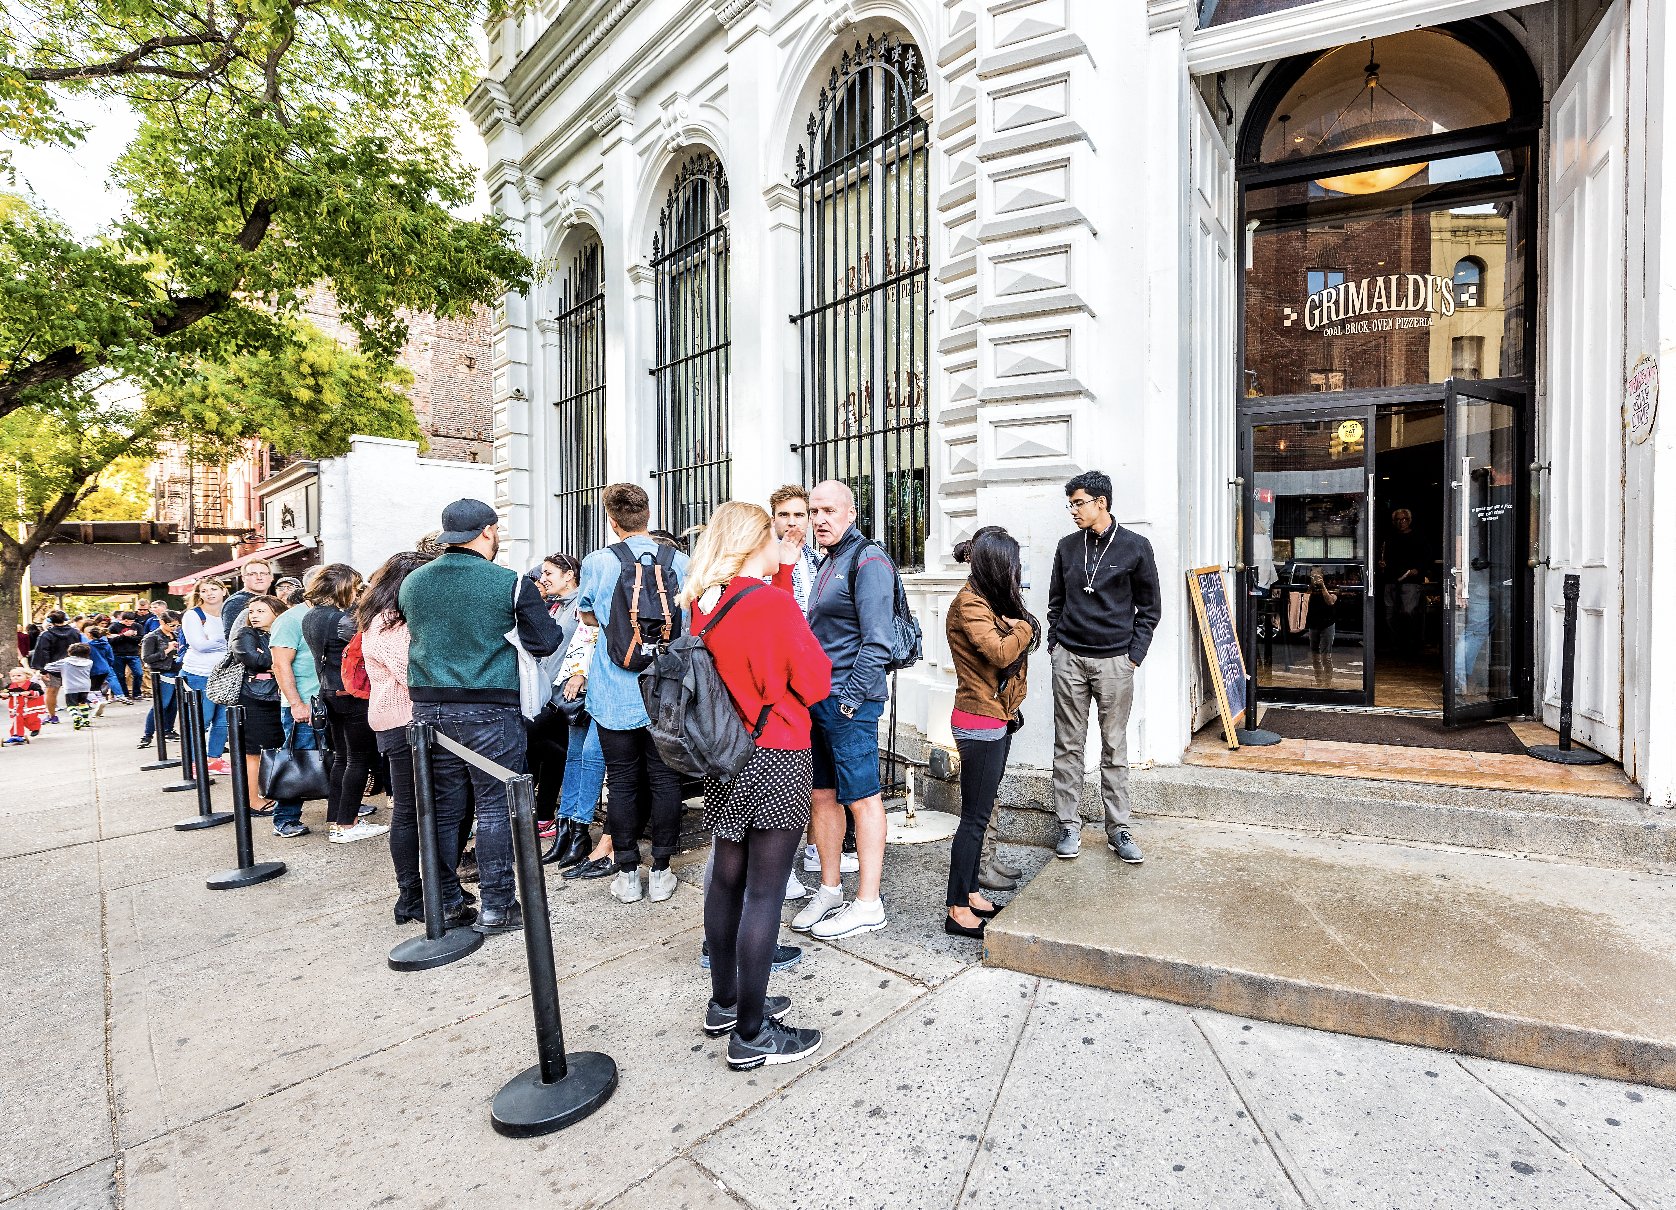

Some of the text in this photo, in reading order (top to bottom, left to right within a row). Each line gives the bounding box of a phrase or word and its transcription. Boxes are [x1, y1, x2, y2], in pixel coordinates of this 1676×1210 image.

[1304, 274, 1455, 331] GRIMALDI'S
[1323, 325, 1343, 337] COAL
[1395, 317, 1433, 330] PIZZERIA
